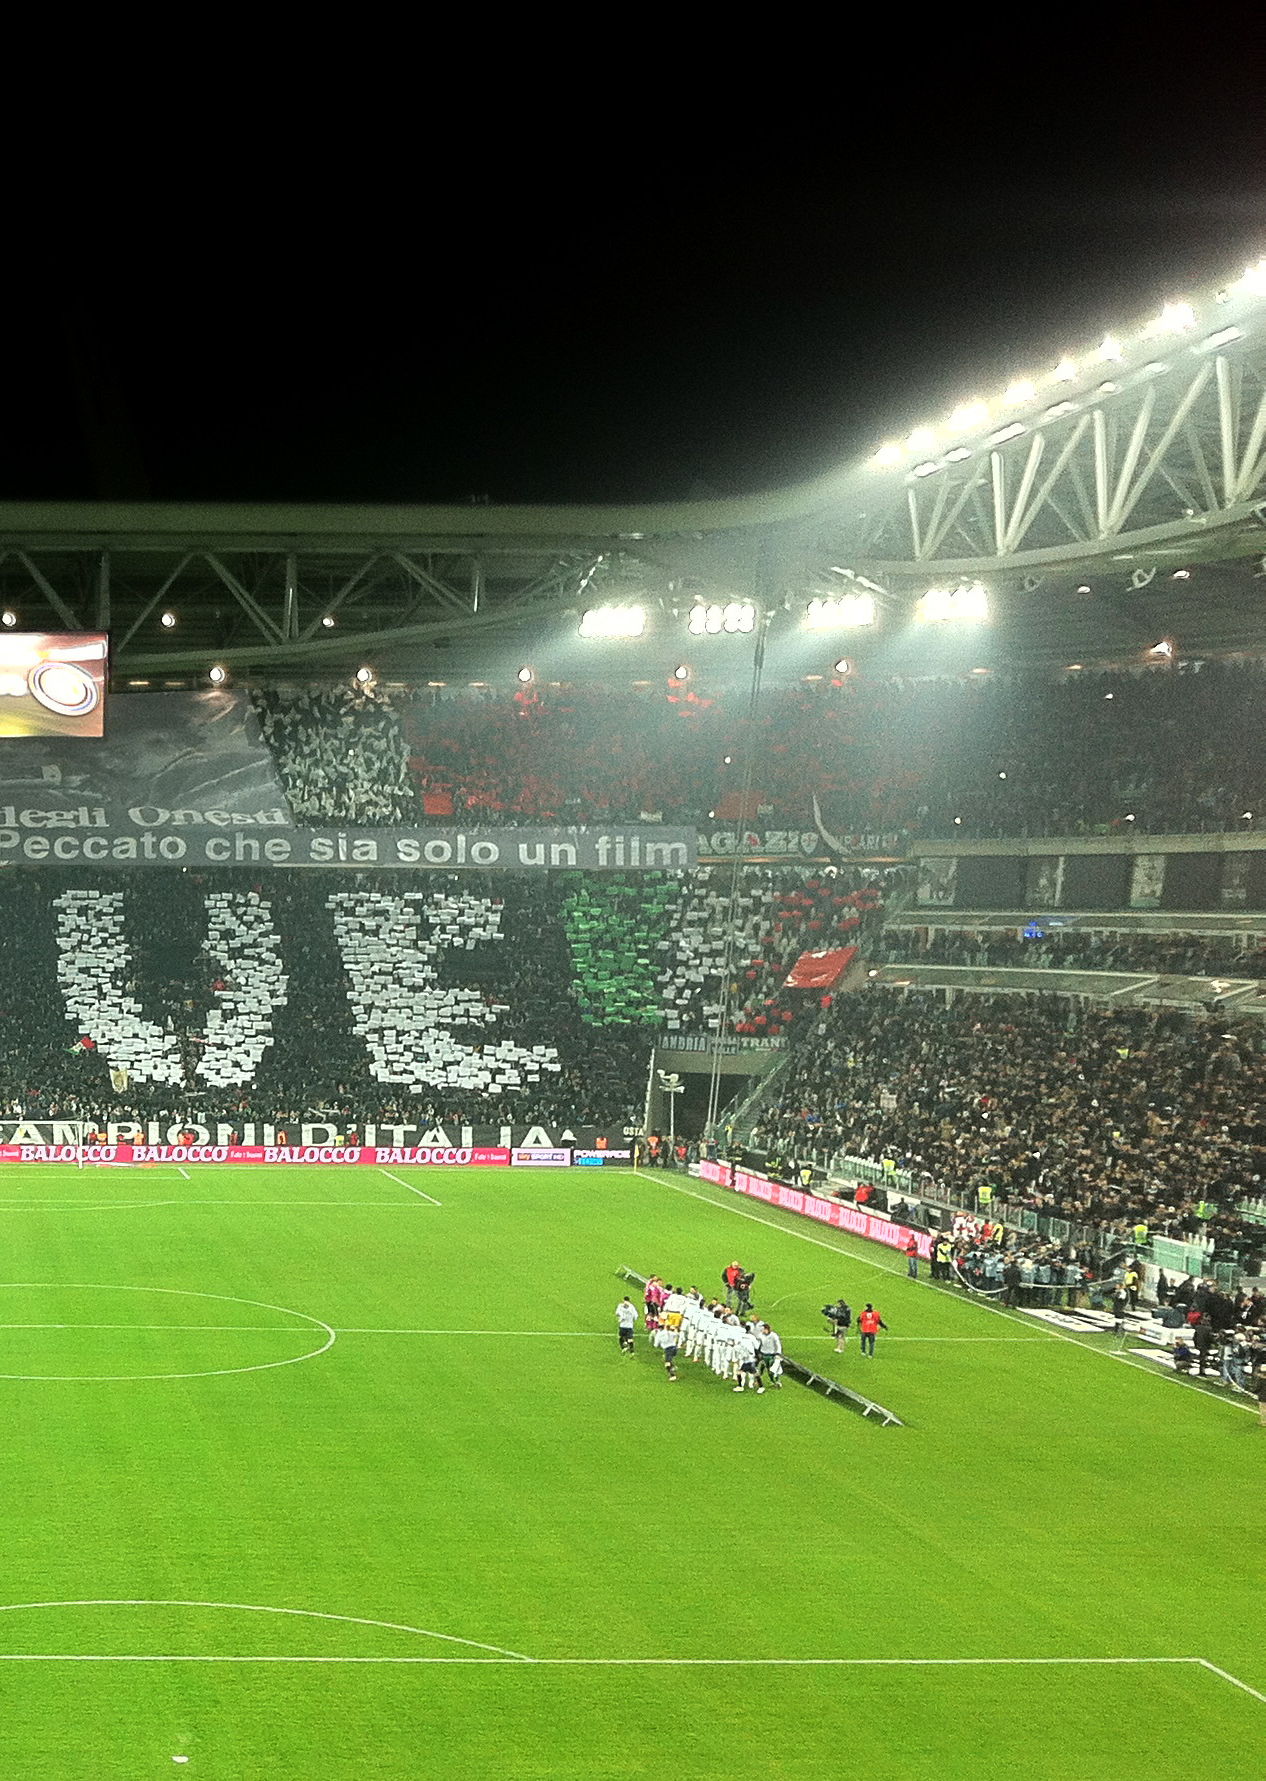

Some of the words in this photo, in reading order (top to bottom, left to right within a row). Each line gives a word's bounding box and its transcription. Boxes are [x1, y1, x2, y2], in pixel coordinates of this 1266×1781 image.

[204, 831, 292, 862] che
[309, 832, 379, 863] sia
[396, 833, 500, 866] solo
[519, 842, 577, 867] un
[595, 834, 688, 867] film
[21, 1145, 117, 1162] BALOCCO
[131, 1146, 230, 1162] BALOCCO
[264, 1147, 362, 1163] BALOCCO
[375, 1148, 474, 1164] BALOCCO
